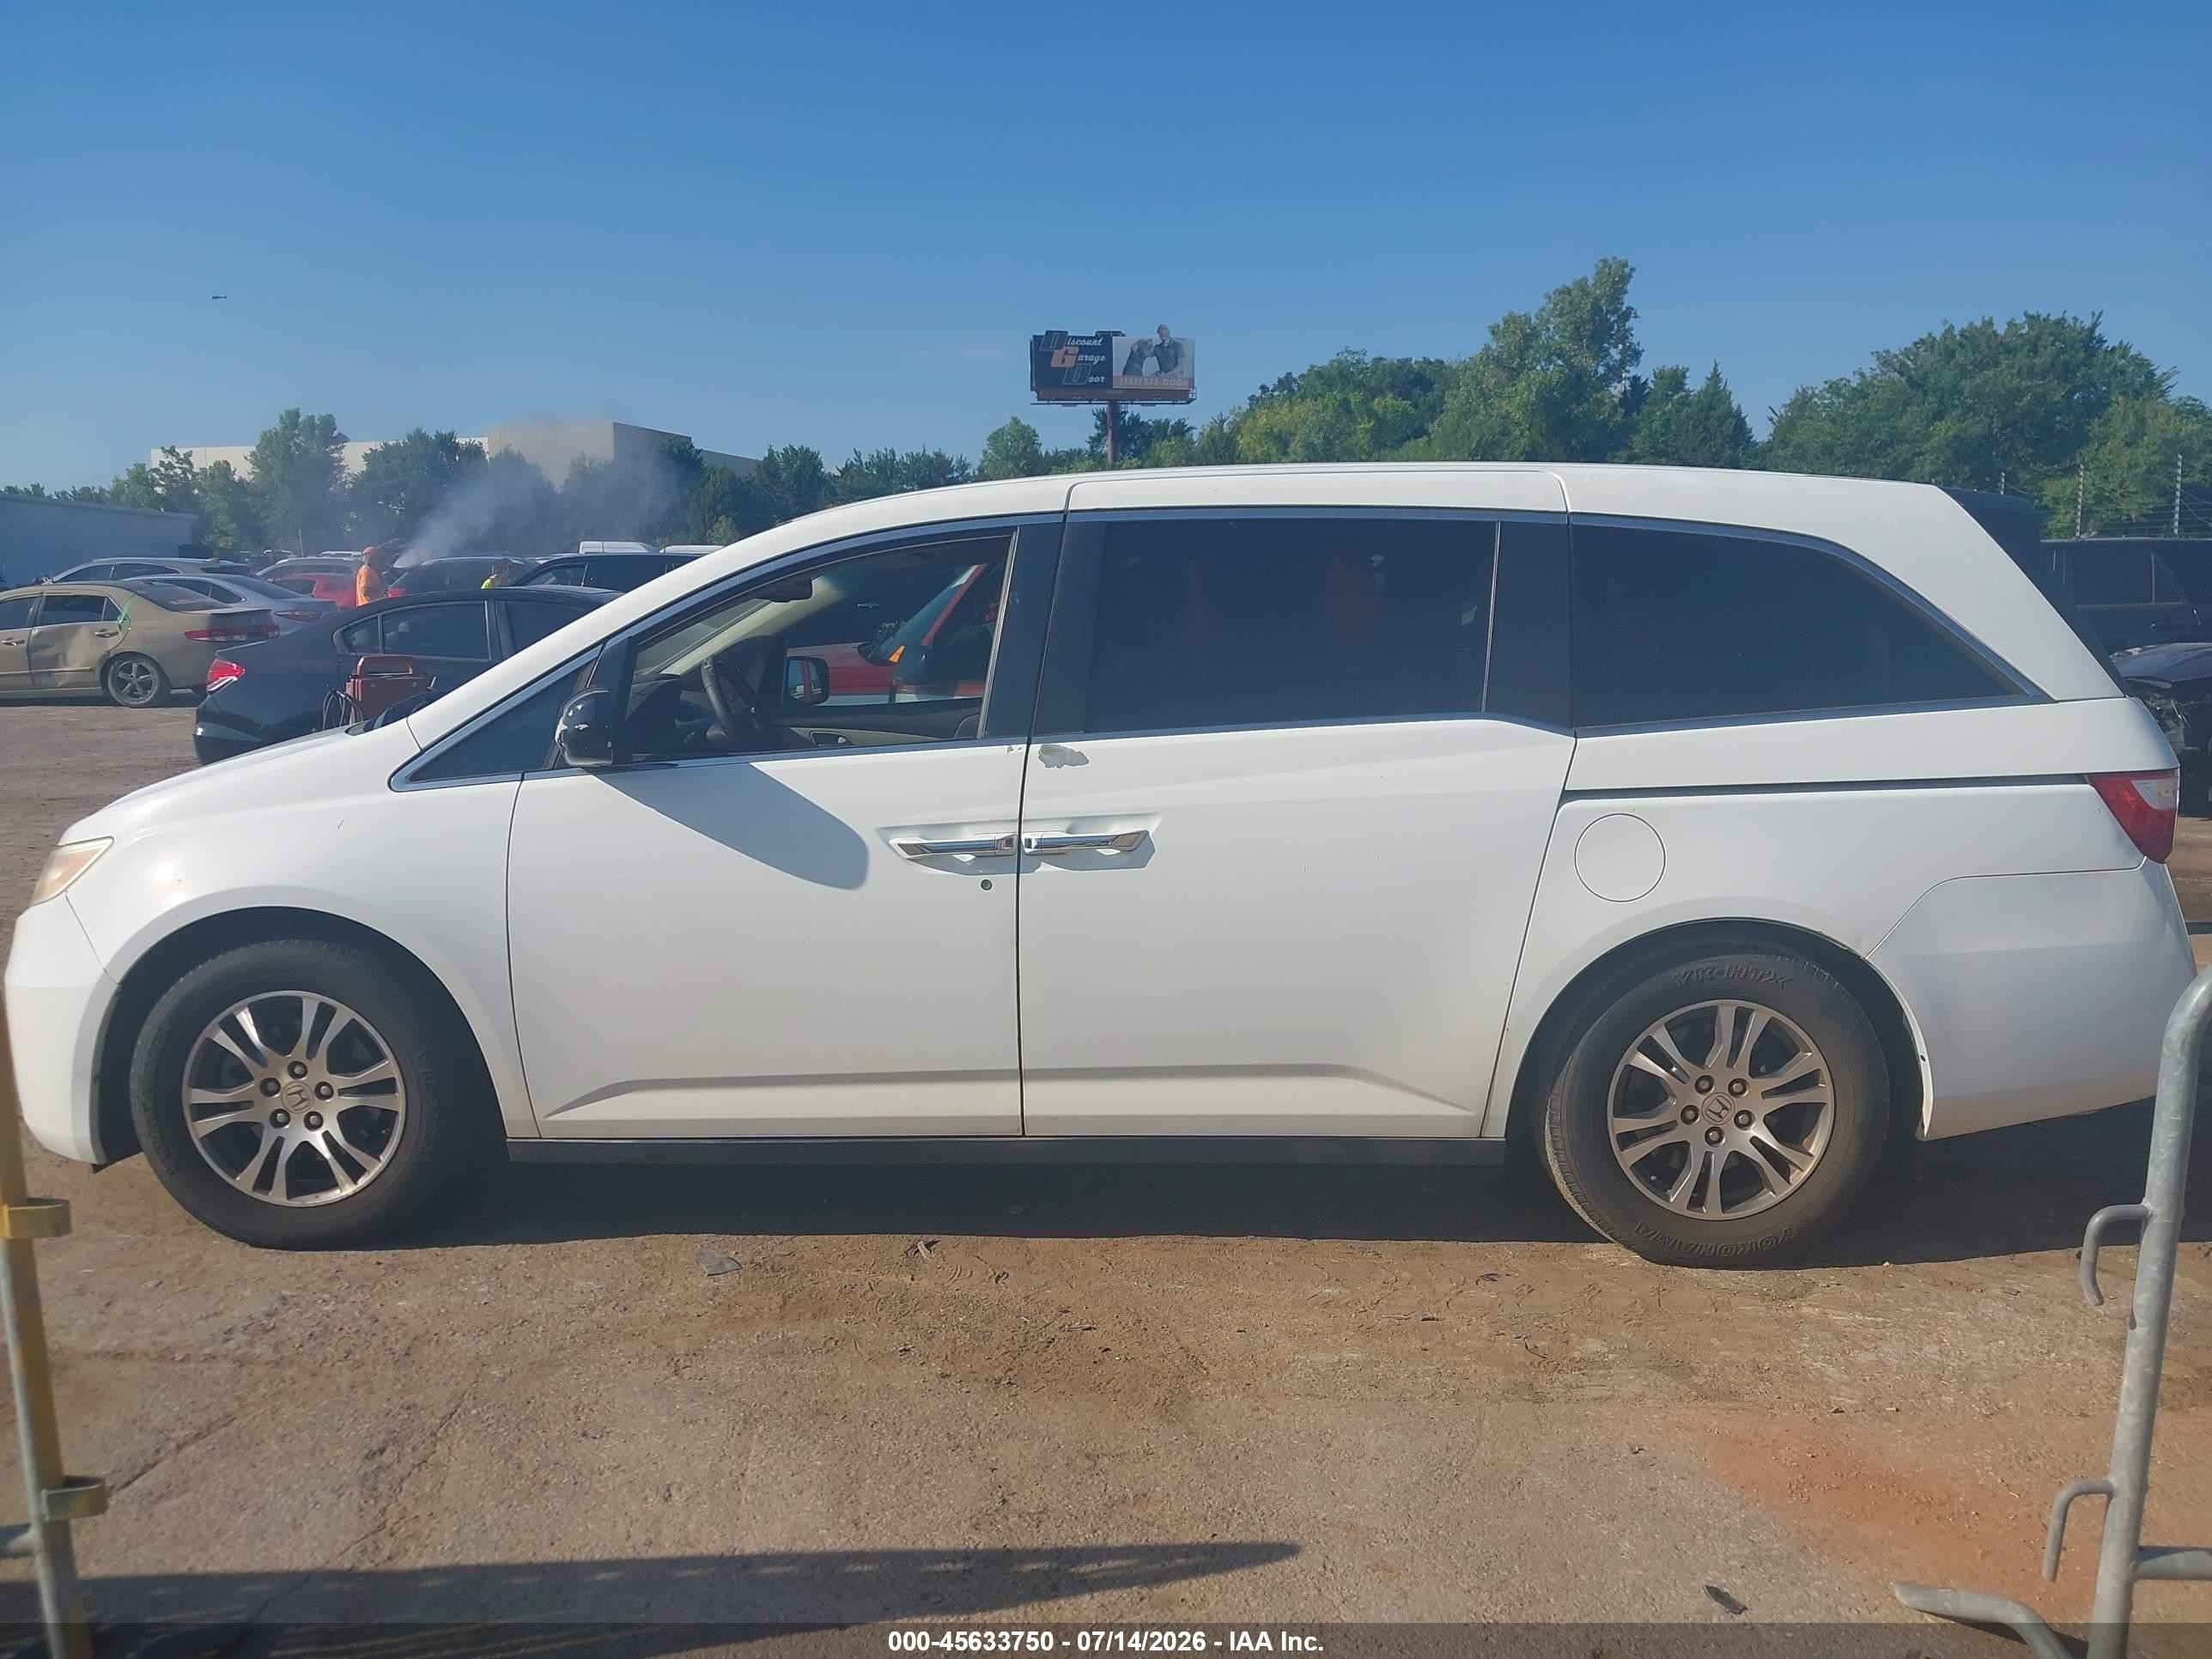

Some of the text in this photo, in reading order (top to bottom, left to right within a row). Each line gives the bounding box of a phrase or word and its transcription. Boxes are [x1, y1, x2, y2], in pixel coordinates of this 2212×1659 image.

[1039, 331, 1103, 350] Discount
[1050, 347, 1106, 368] Garage
[1062, 364, 1106, 385] Door
[1633, 1221, 1797, 1257] YOKOHAMA
